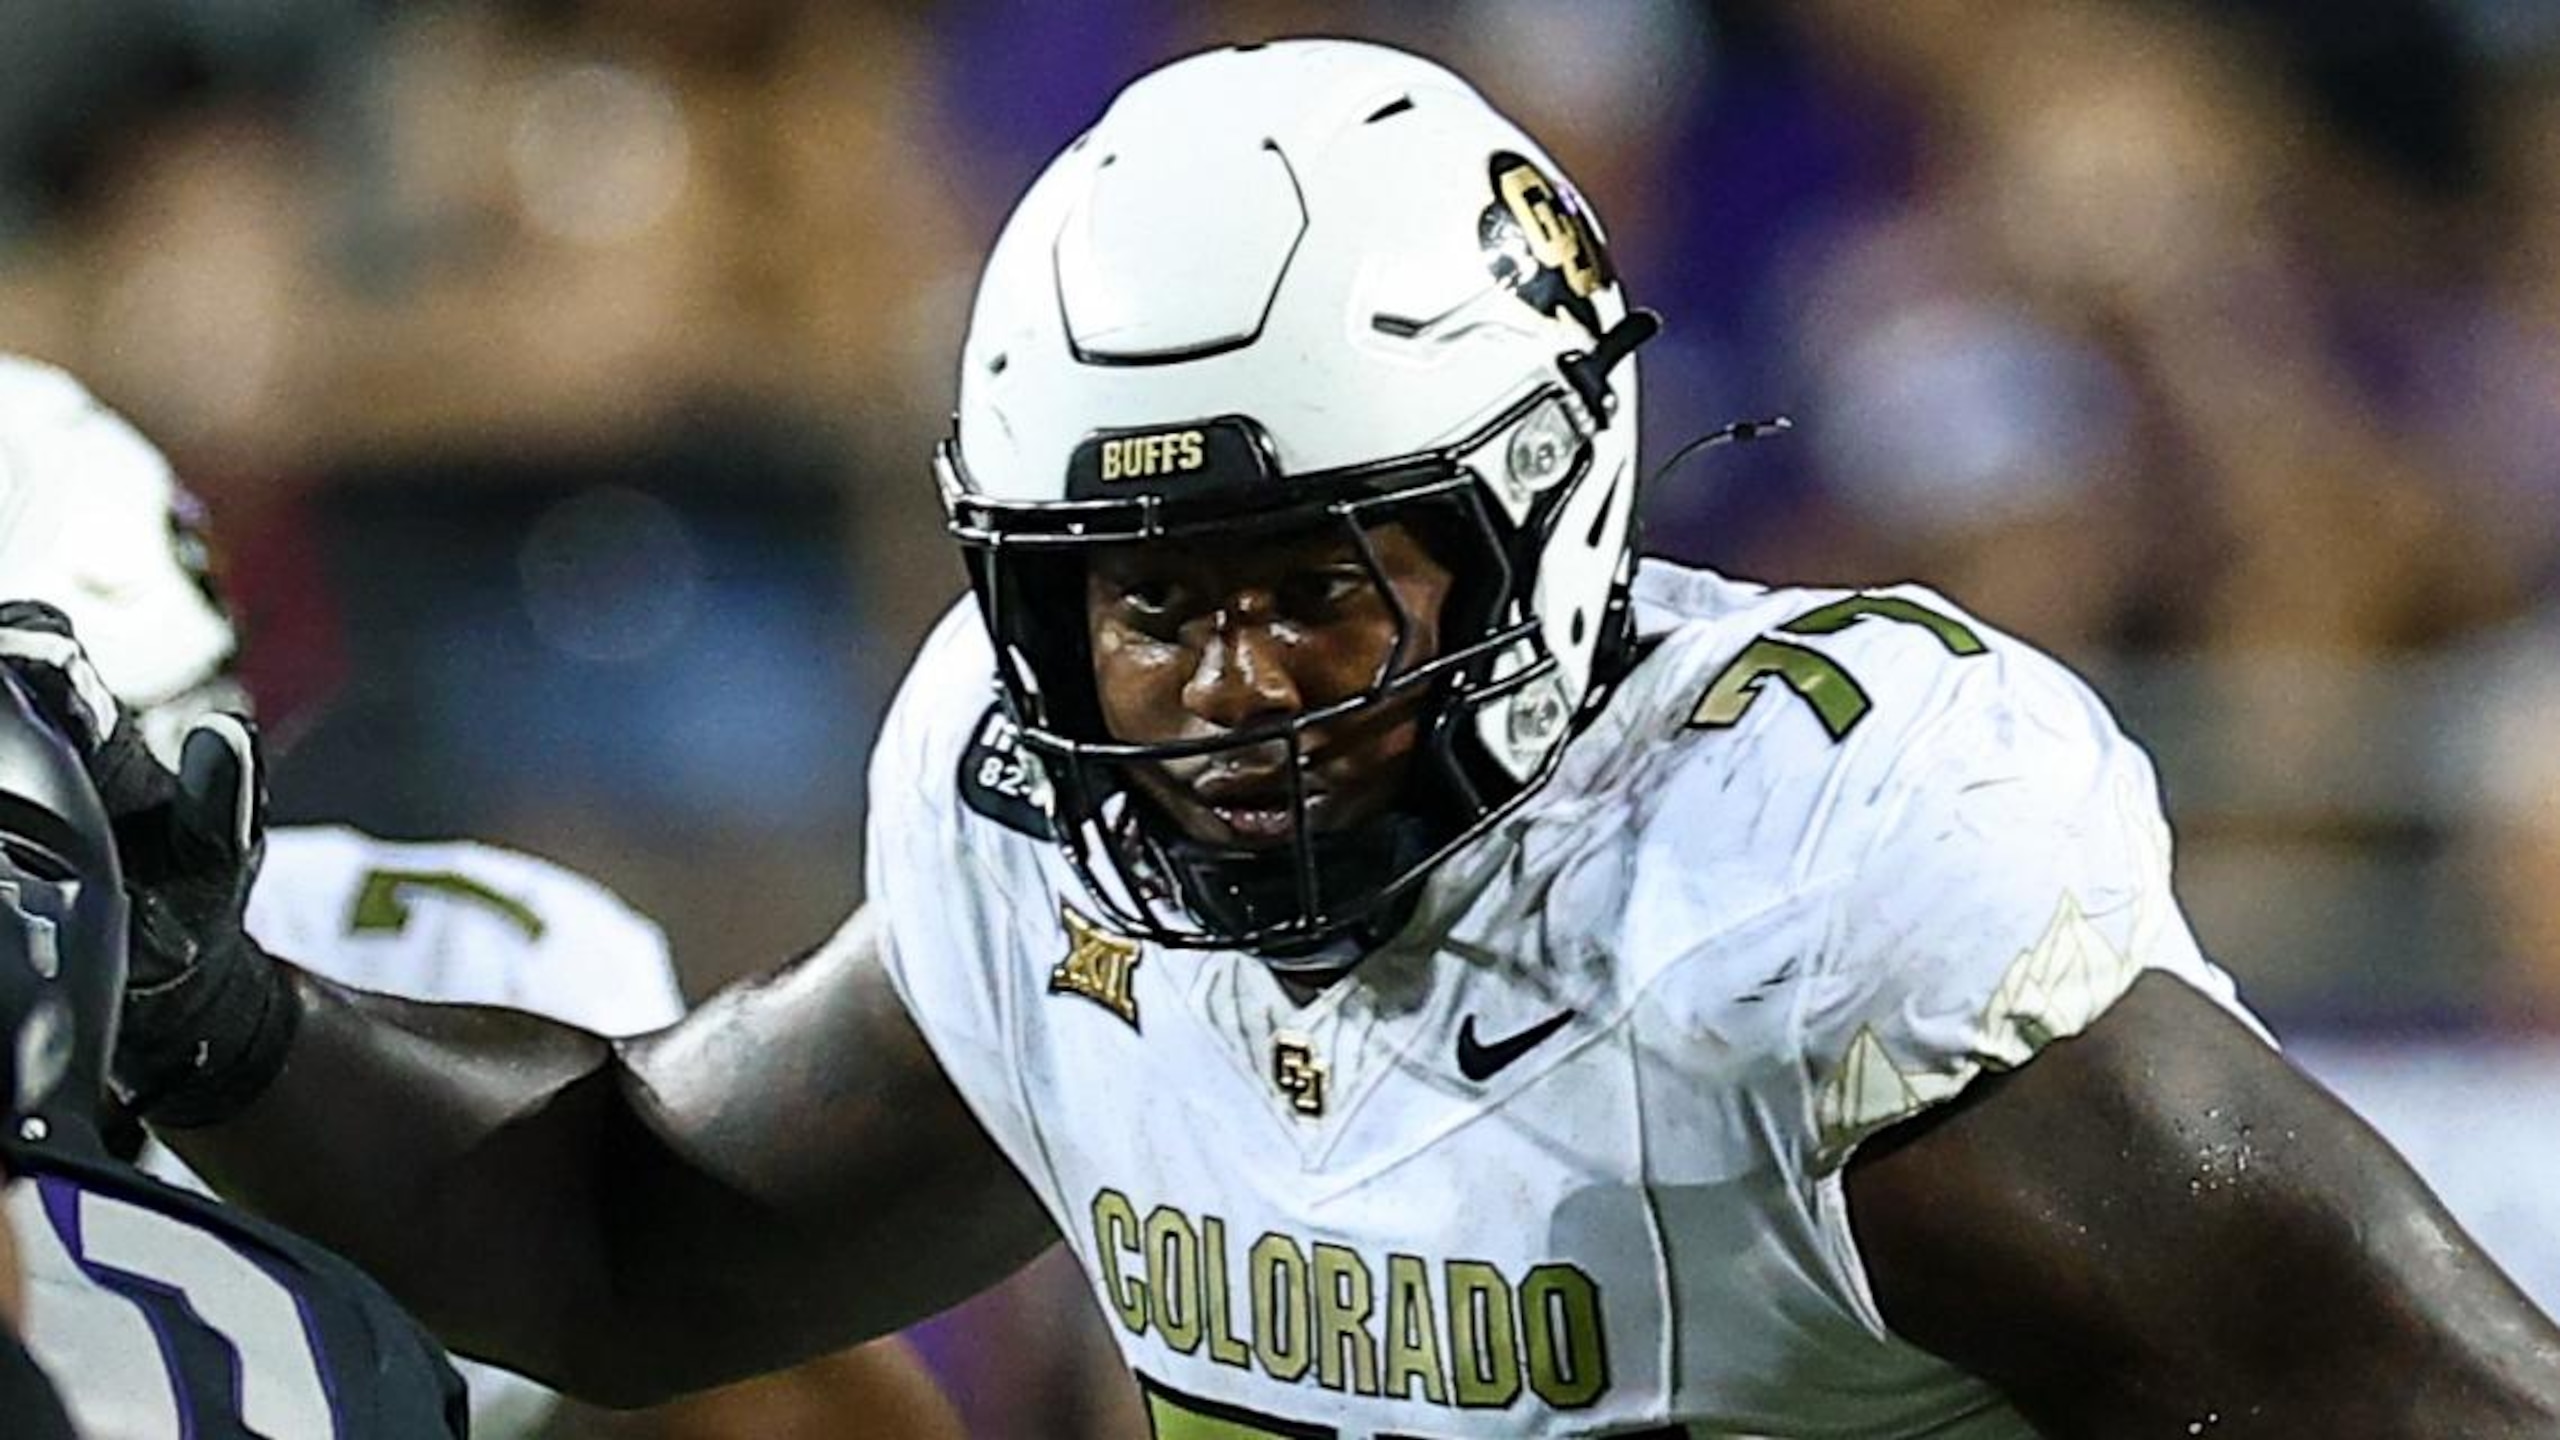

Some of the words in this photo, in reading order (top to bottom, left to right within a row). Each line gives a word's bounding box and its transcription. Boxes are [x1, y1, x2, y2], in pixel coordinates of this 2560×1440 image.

[1102, 430, 1204, 481] BUFFS
[1686, 593, 1991, 743] 77
[1091, 1187, 1612, 1409] COLORADO
